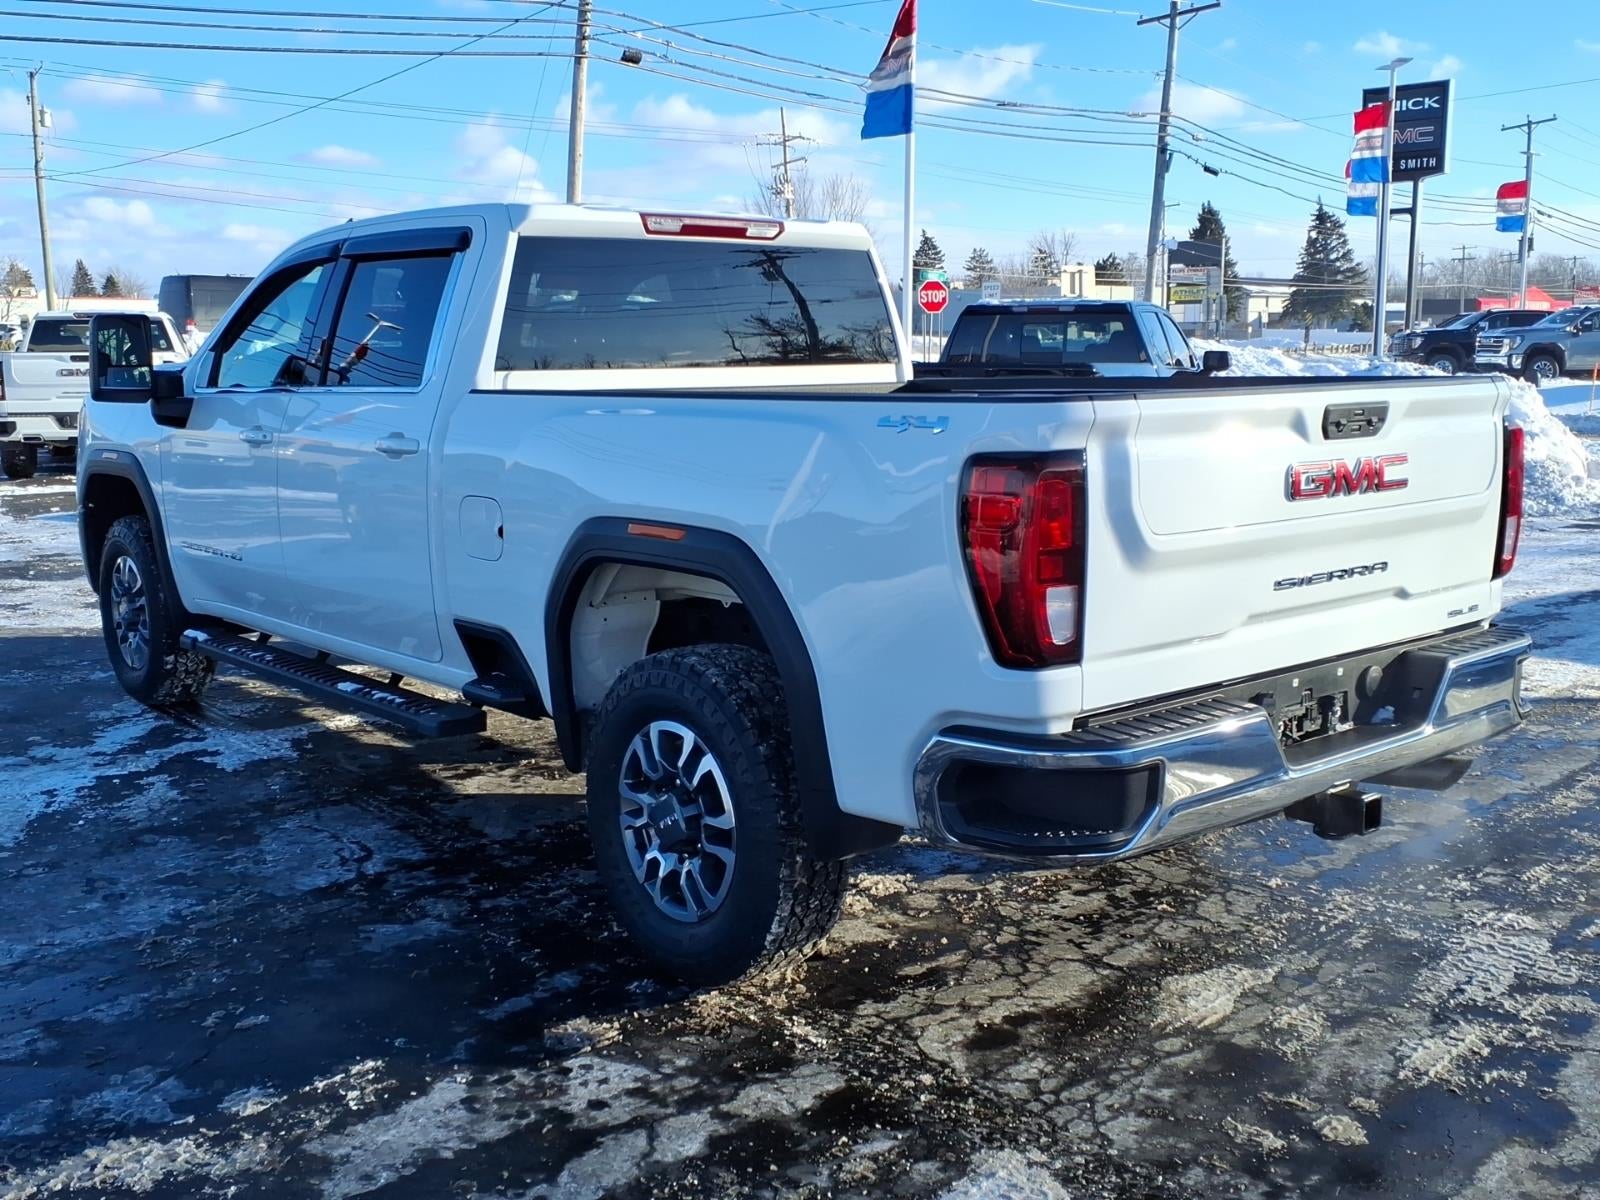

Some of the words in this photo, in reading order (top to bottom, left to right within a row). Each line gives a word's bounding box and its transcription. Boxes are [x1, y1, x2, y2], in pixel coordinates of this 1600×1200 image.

[1393, 126, 1434, 144] MC
[1400, 157, 1436, 170] SMITH
[920, 290, 946, 303] STOP
[57, 368, 90, 377] GM
[1284, 453, 1409, 502] GMC
[1273, 561, 1389, 591] SIERRA
[1447, 604, 1479, 618] SLE
